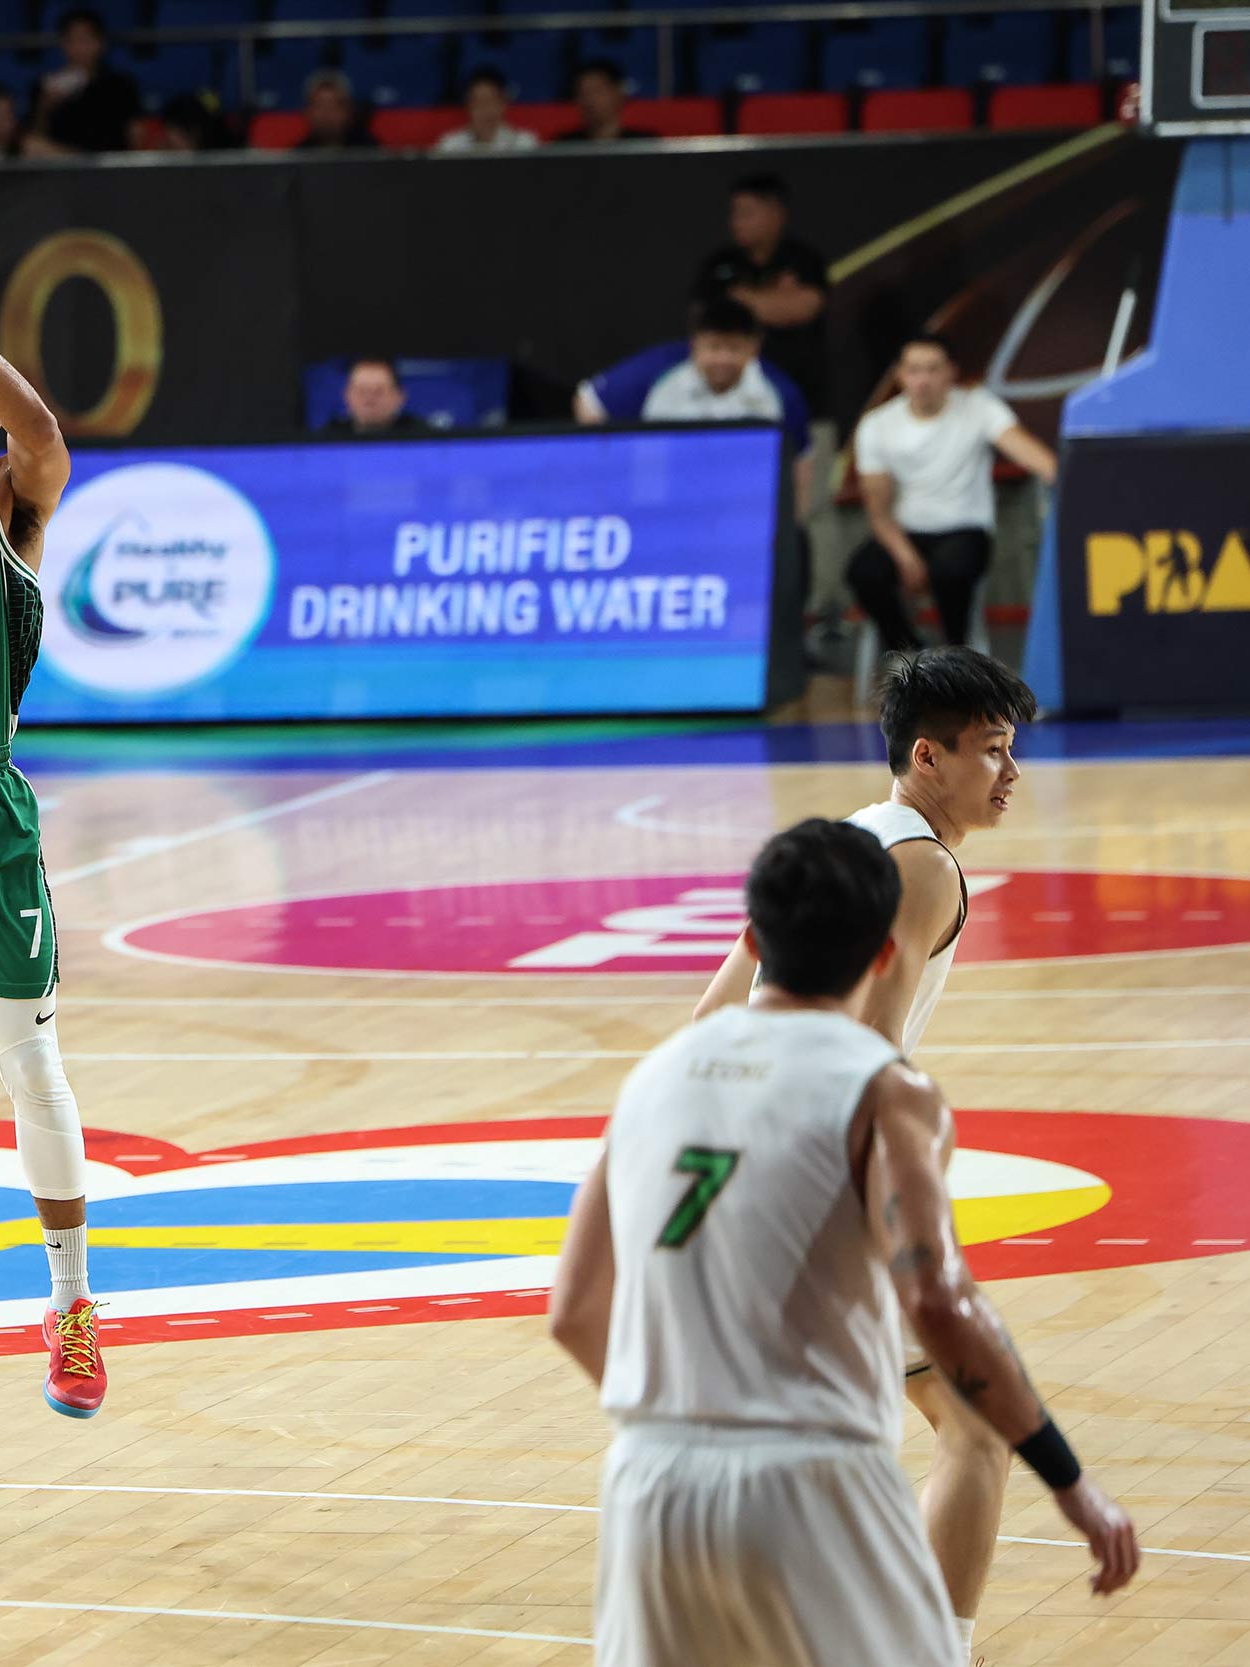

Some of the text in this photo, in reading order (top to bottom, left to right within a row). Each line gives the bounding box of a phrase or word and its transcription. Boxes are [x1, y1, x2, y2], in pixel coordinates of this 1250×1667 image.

[393, 516, 633, 576] PURIFIED
[1085, 530, 1250, 616] PBA
[112, 577, 226, 620] PURE
[288, 575, 728, 639] DRINKING WATER
[19, 907, 43, 959] 7
[654, 1145, 741, 1251] 7
